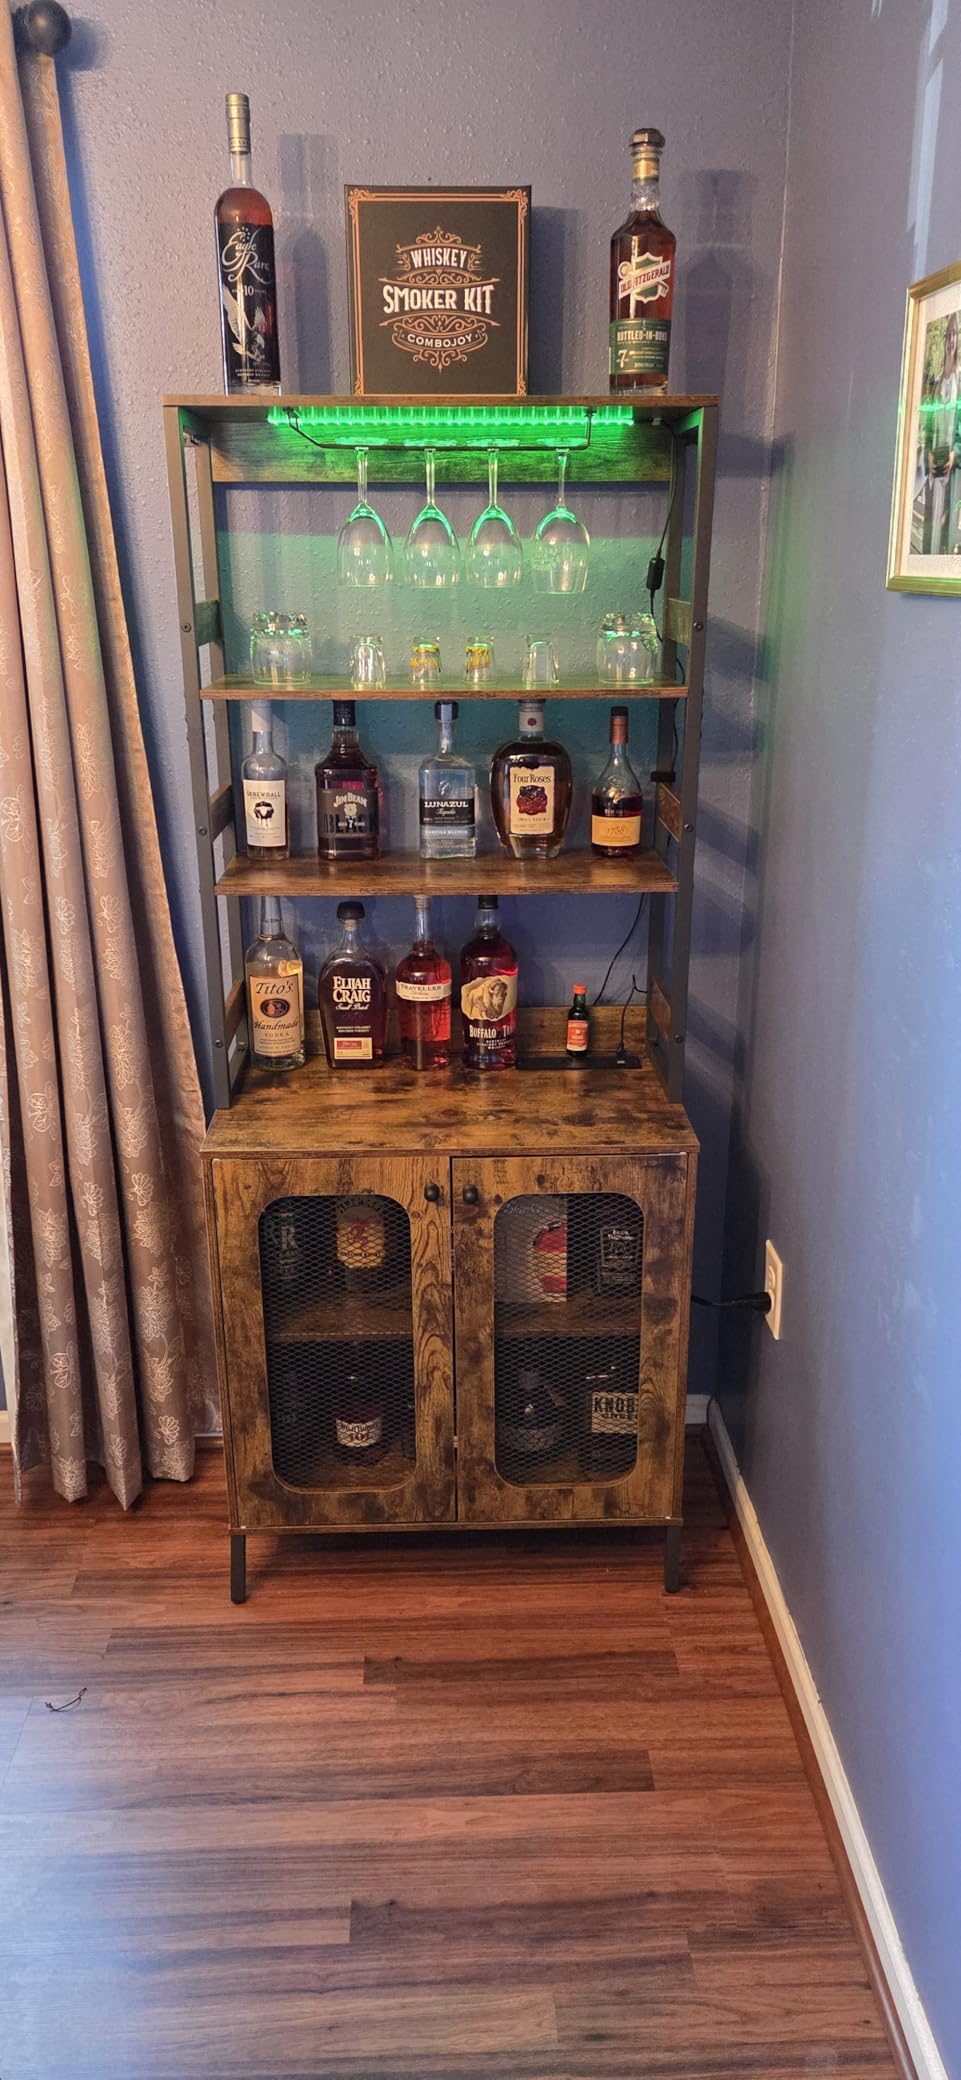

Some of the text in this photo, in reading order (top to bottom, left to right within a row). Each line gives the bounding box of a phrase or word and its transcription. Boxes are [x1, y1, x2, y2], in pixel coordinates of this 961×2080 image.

[222, 231, 261, 272] Eagle
[410, 247, 468, 269] WHISKEY
[228, 251, 272, 284] Rare
[243, 285, 255, 296] 10
[382, 284, 495, 314] SMOKER KIT
[407, 333, 474, 348] COMBOJOY
[616, 349, 630, 369] 7
[513, 773, 552, 784] Four Roses
[333, 791, 368, 808] JIM BEAM
[348, 819, 354, 829] 7
[255, 980, 294, 995] Tito's
[333, 975, 371, 991] ELIJAH
[332, 988, 371, 1003] CRAIG
[254, 1015, 298, 1030] Handmade
[469, 1025, 497, 1039] BUFFALO
[593, 1397, 635, 1413] KNOB
